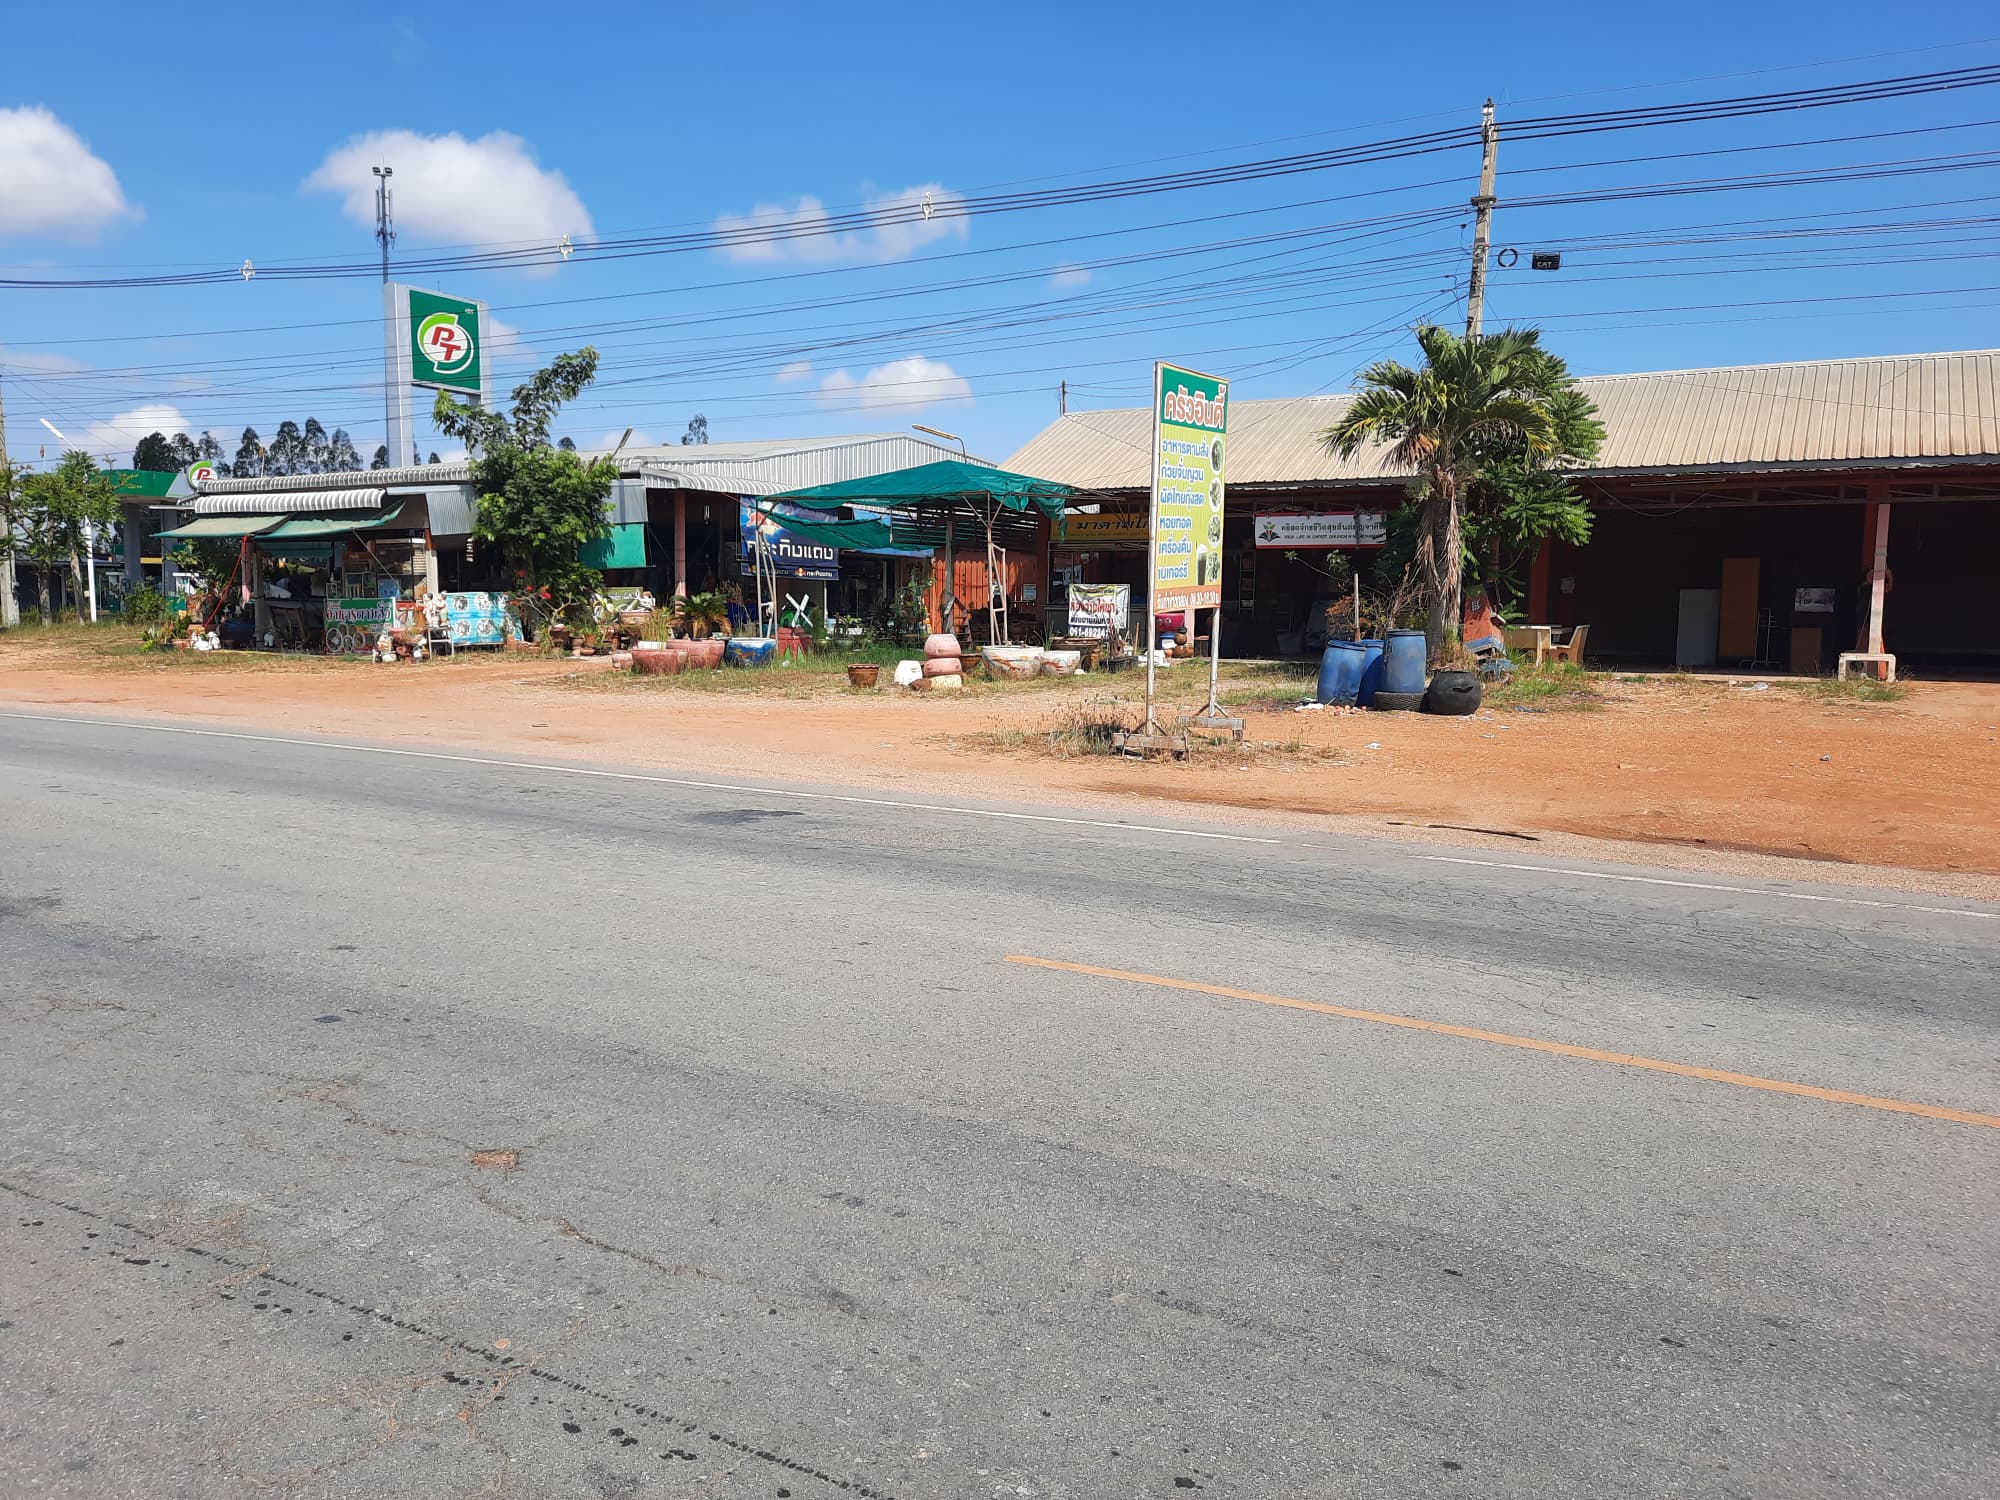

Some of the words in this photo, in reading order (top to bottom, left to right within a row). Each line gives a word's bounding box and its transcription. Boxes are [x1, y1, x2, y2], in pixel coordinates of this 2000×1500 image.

[431, 326, 461, 361] PT
[1162, 437, 1209, 457] อาหารตามสั่ง
[1160, 487, 1205, 511] ผัดไทยกุ้งสด
[1159, 516, 1192, 530] หอยทอด
